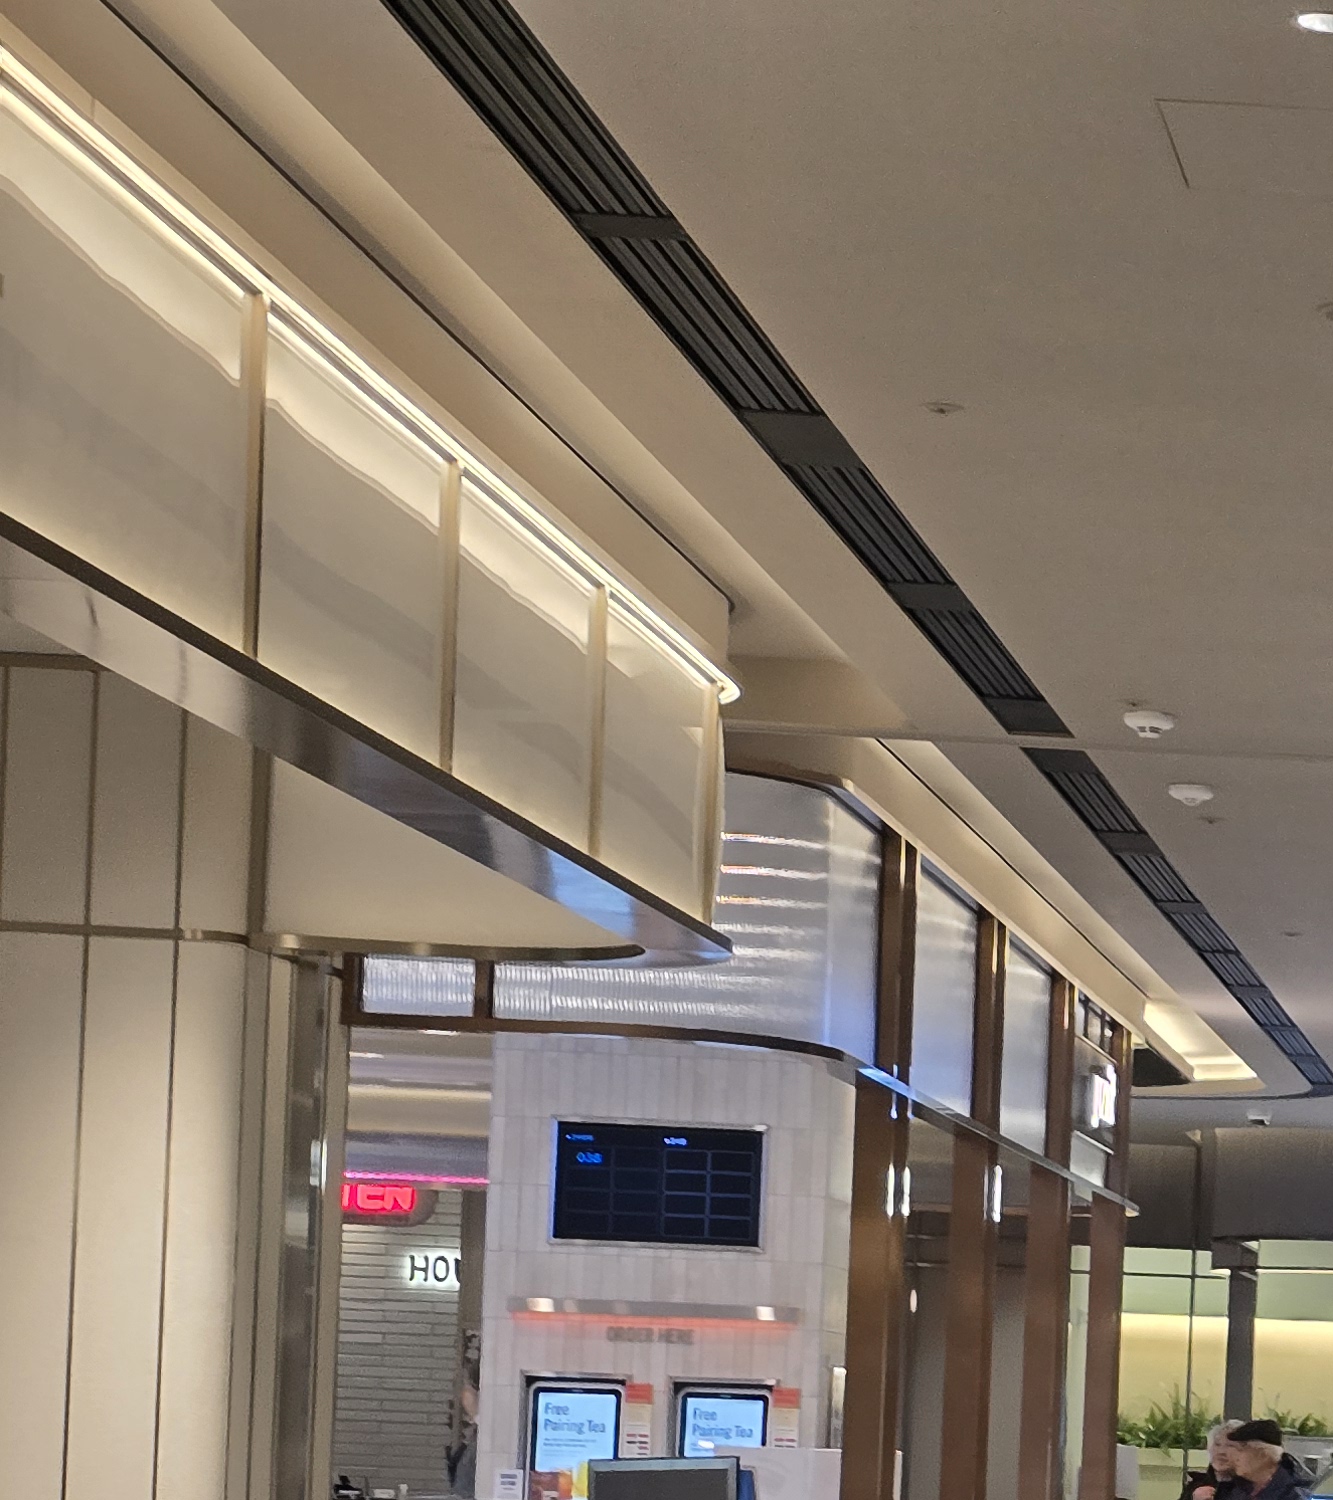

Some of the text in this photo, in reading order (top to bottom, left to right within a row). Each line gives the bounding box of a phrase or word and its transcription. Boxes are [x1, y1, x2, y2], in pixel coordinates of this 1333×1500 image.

[606, 1326, 695, 1345] ORDER HERE
[543, 1402, 569, 1416] Free
[692, 1408, 718, 1422] Free
[543, 1420, 606, 1435] Pairing Tea
[692, 1424, 754, 1440] Pairing Tea
